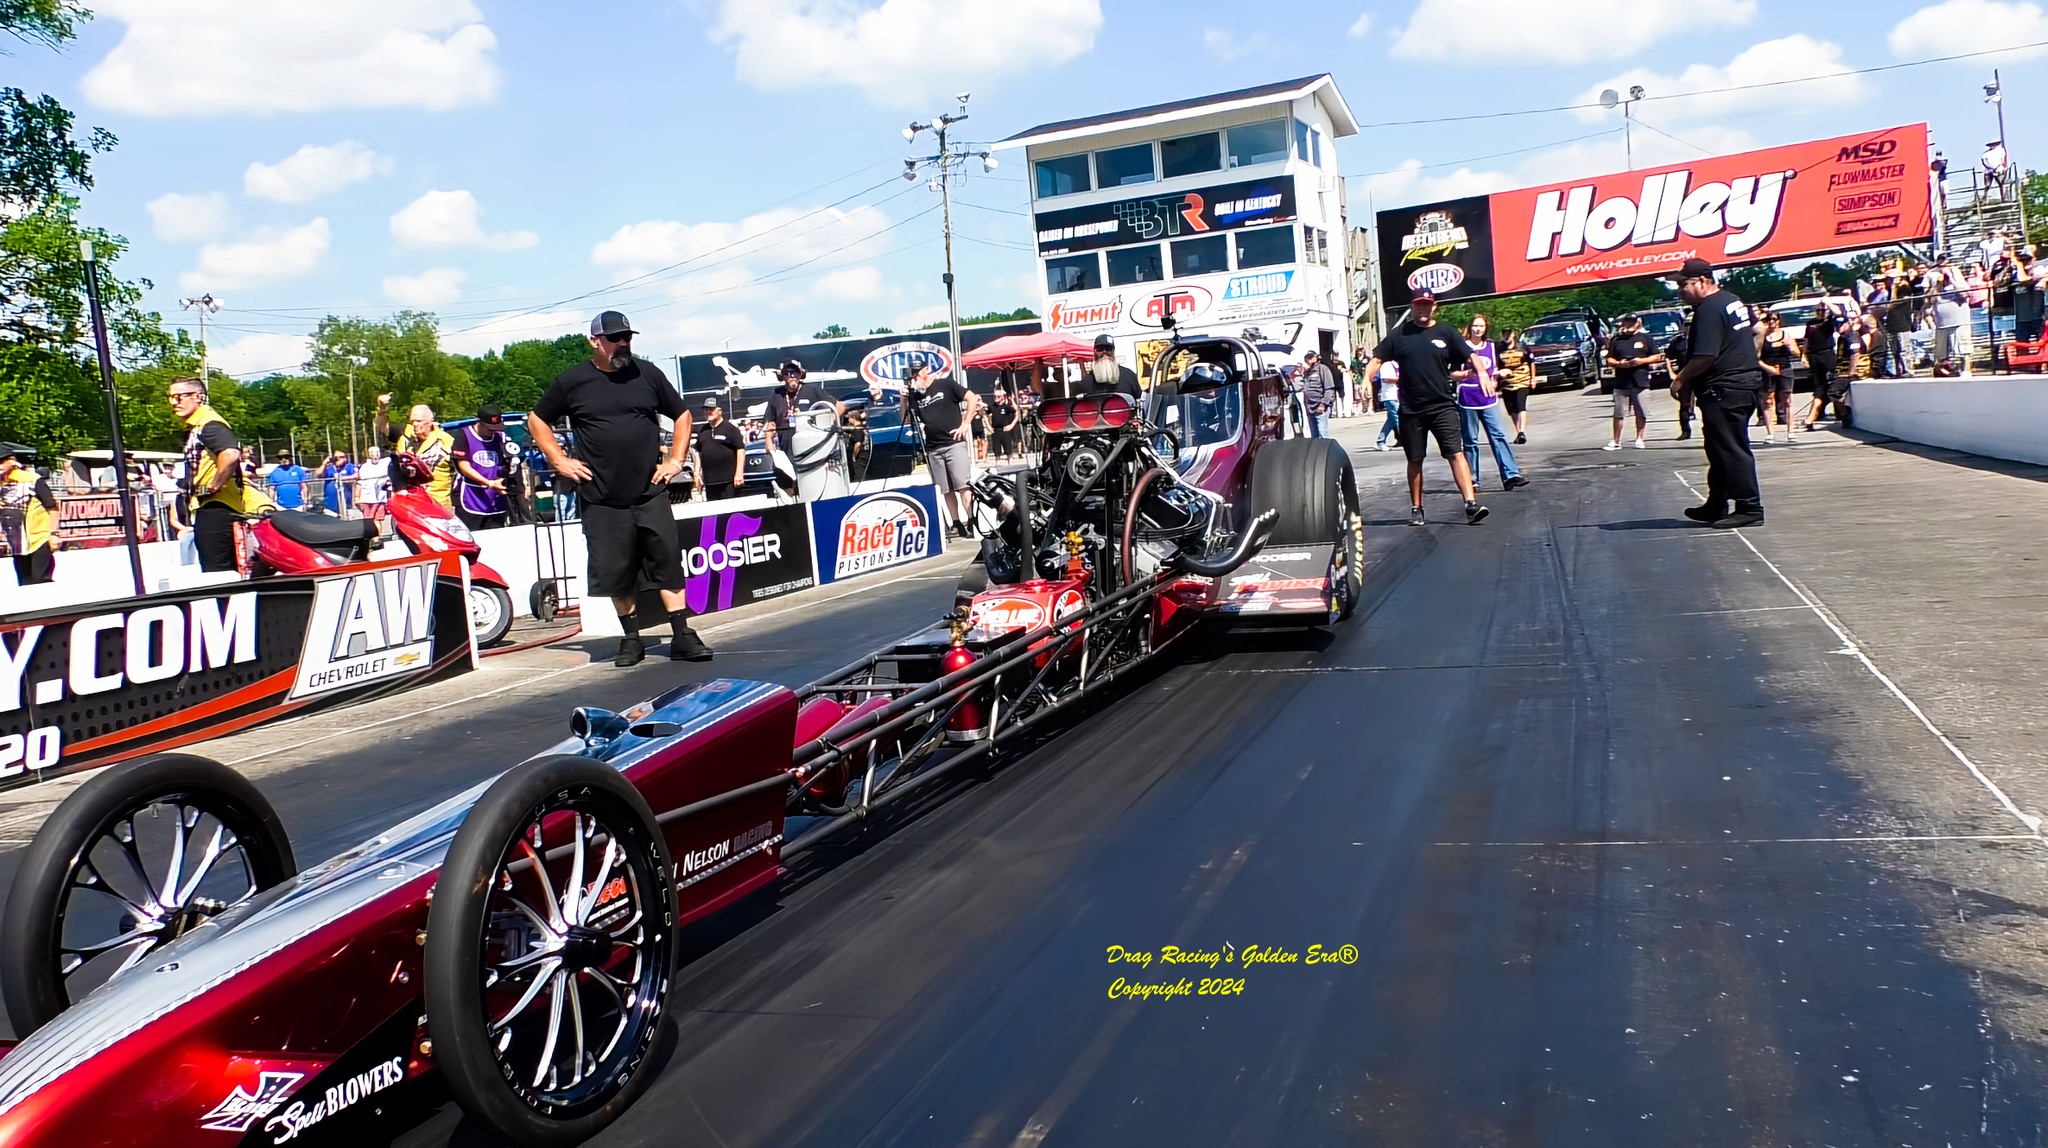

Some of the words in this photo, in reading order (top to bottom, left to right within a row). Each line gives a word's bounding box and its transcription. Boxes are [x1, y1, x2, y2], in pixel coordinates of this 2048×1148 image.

[1836, 140, 1897, 162] MSD
[1827, 164, 1905, 192] FLOWMASTER
[1837, 191, 1898, 212] SIMPSON
[1140, 193, 1210, 239] BTR
[1526, 169, 1788, 262] Holley
[1566, 250, 1697, 275] WWW.HOLLEY.COM
[1230, 273, 1287, 298] STROUD
[1416, 269, 1457, 289] NHRA
[1051, 302, 1119, 331] SUMMIT
[1147, 291, 1196, 318] ATM
[838, 550, 893, 574] PISTONS
[309, 658, 387, 688] CHEVROLET
[683, 839, 730, 876] NELSON
[325, 1056, 404, 1117] BLOWERS
